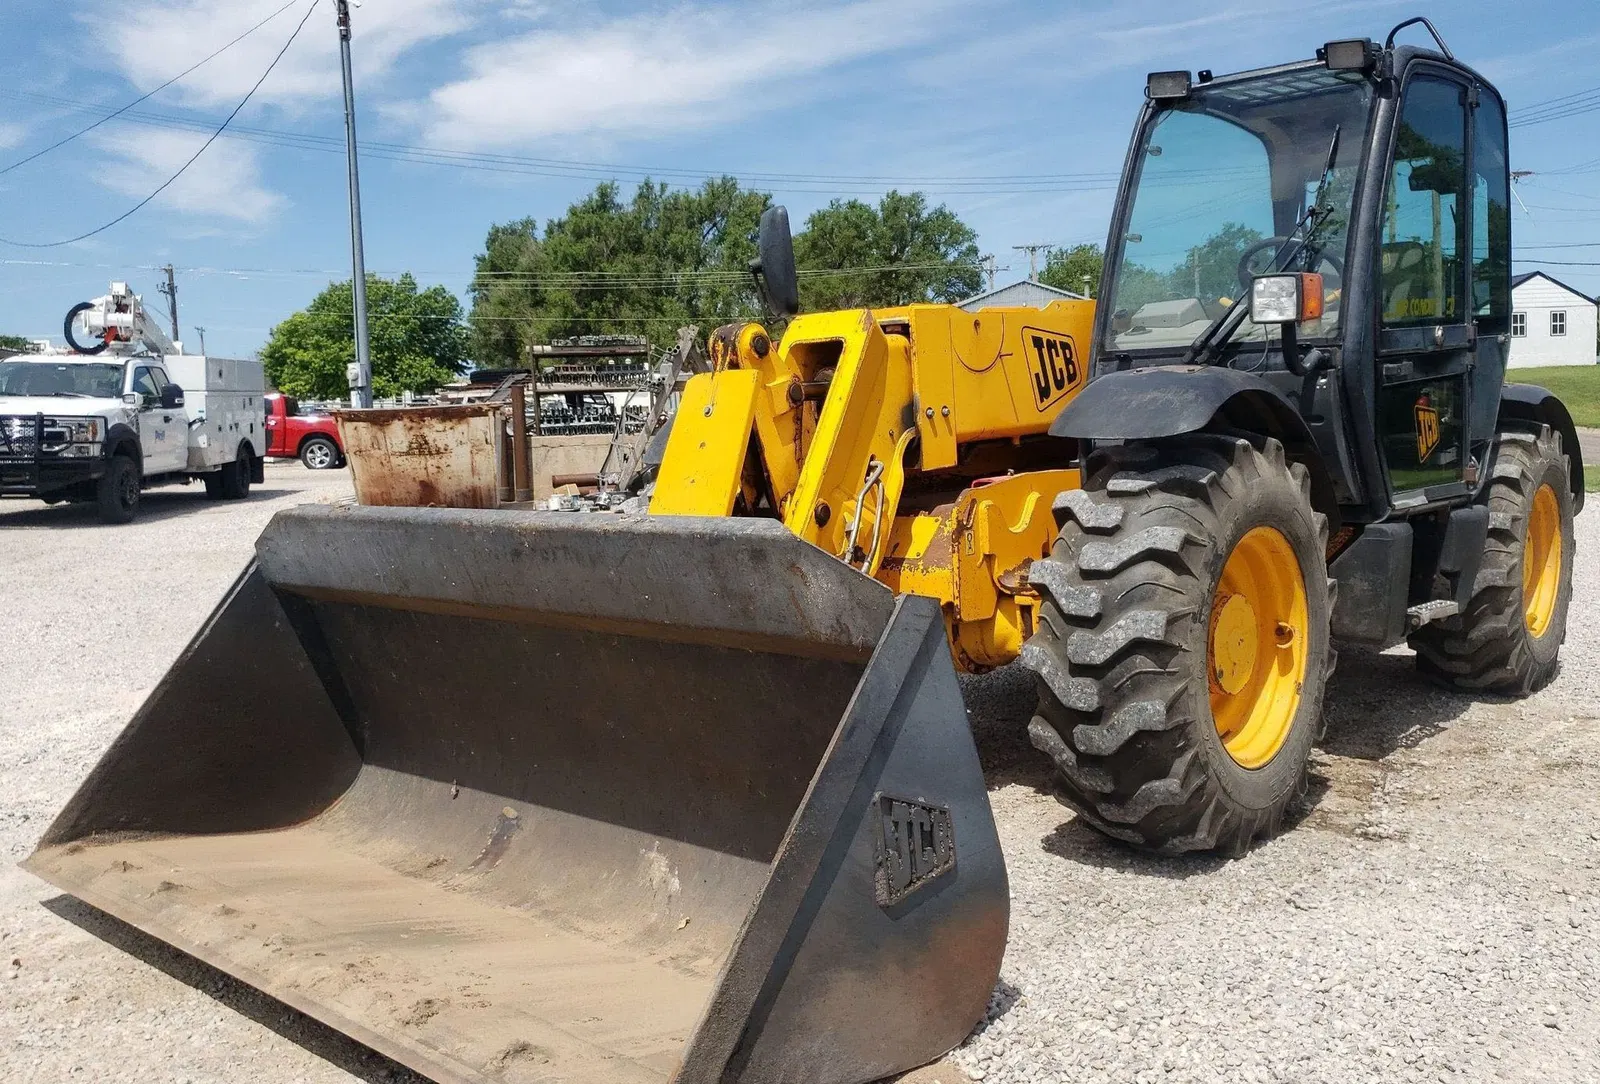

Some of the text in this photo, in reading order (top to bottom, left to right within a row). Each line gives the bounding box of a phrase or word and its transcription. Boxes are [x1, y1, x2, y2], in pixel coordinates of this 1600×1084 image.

[1030, 335, 1078, 404] JCB
[1417, 410, 1438, 457] JCB
[884, 800, 951, 897] JCB
